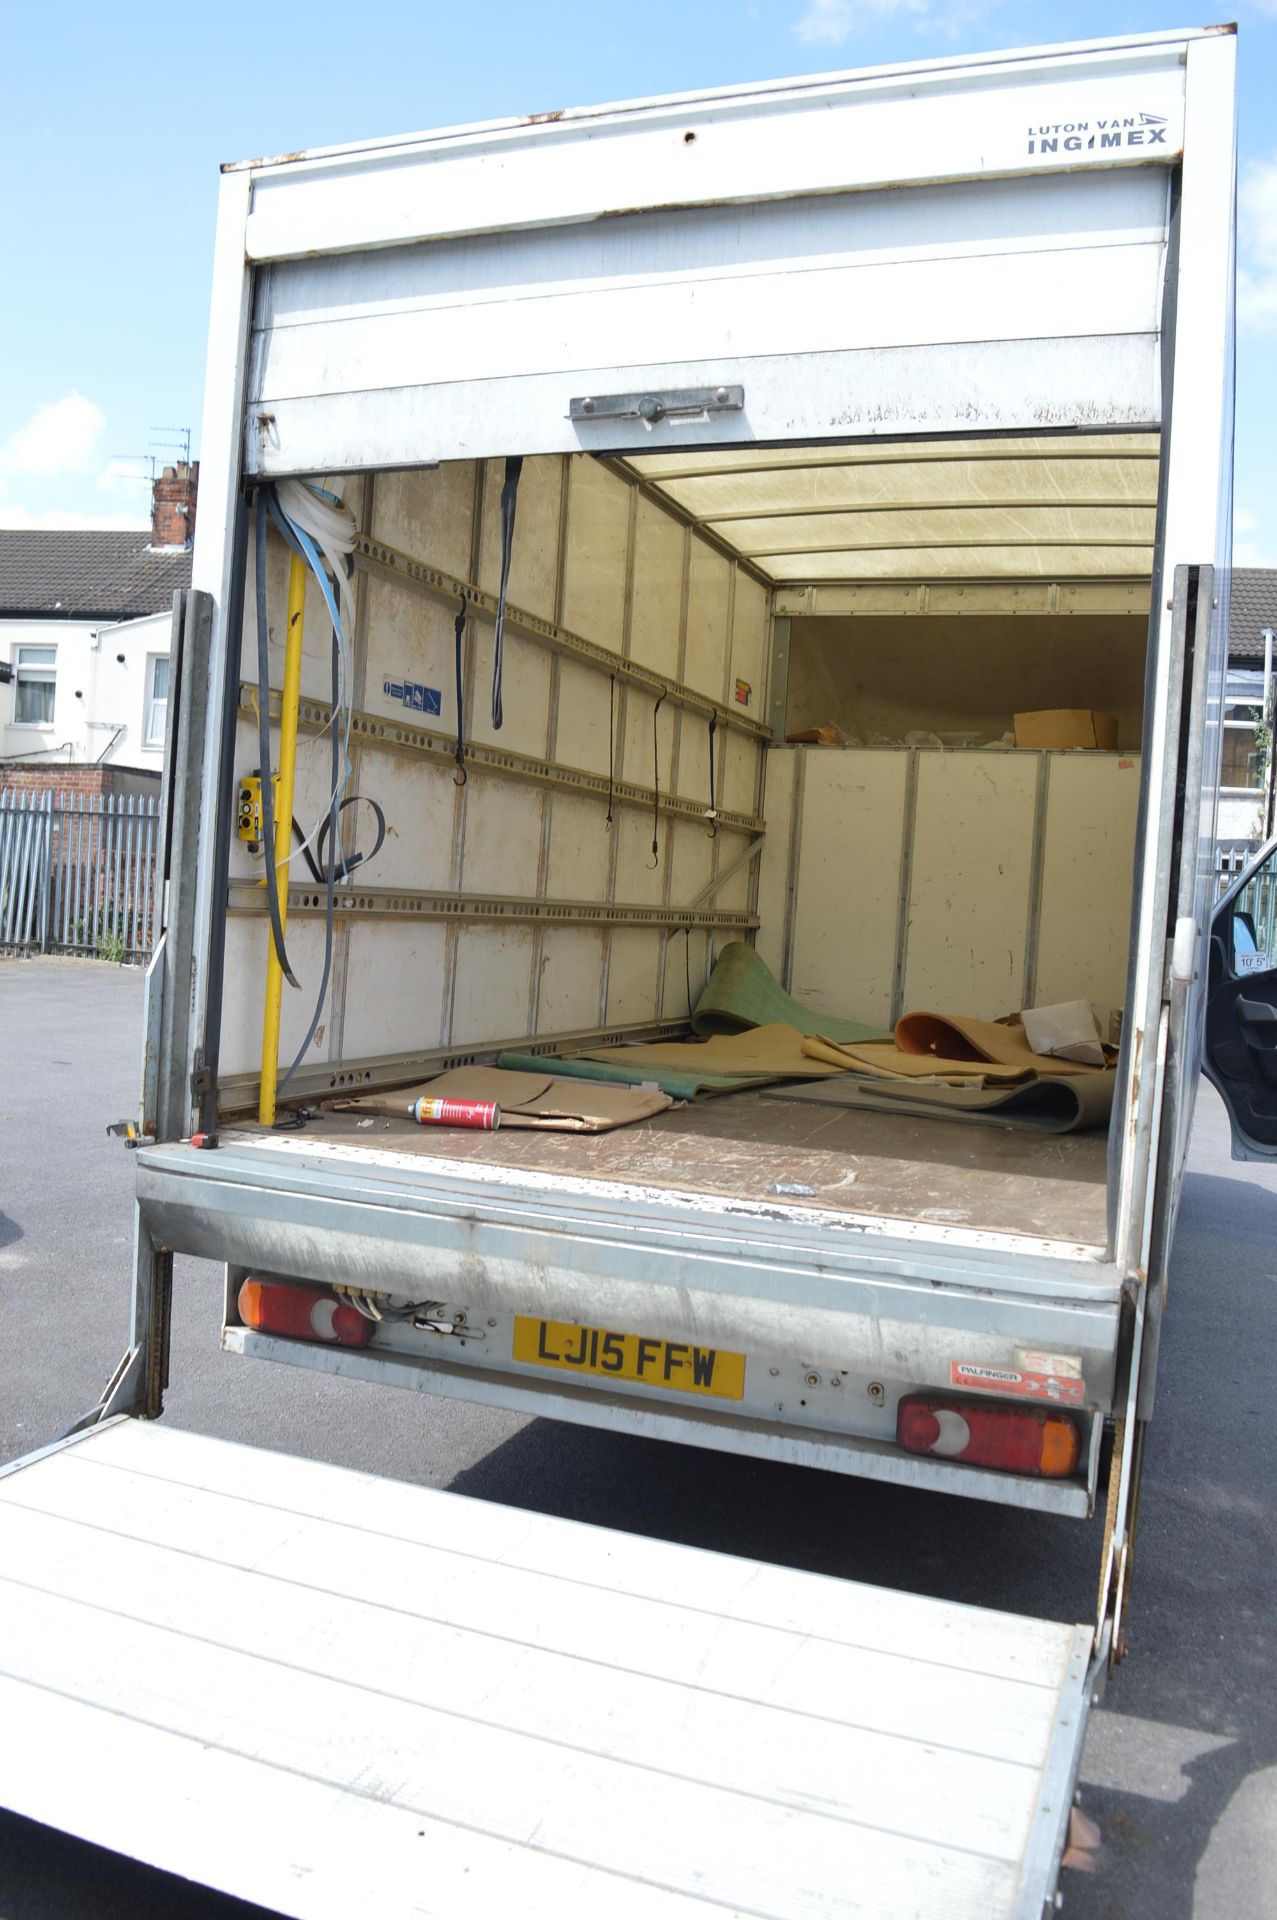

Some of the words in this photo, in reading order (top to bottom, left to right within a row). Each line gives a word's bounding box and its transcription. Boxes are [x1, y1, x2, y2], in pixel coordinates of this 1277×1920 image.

[1028, 122, 1089, 136] LUTON
[1097, 118, 1134, 129] VAN
[1028, 128, 1167, 154] INGIMEX
[538, 1321, 624, 1372] LJ15
[637, 1337, 716, 1387] FFW
[960, 1366, 1018, 1381] PALFINGER
